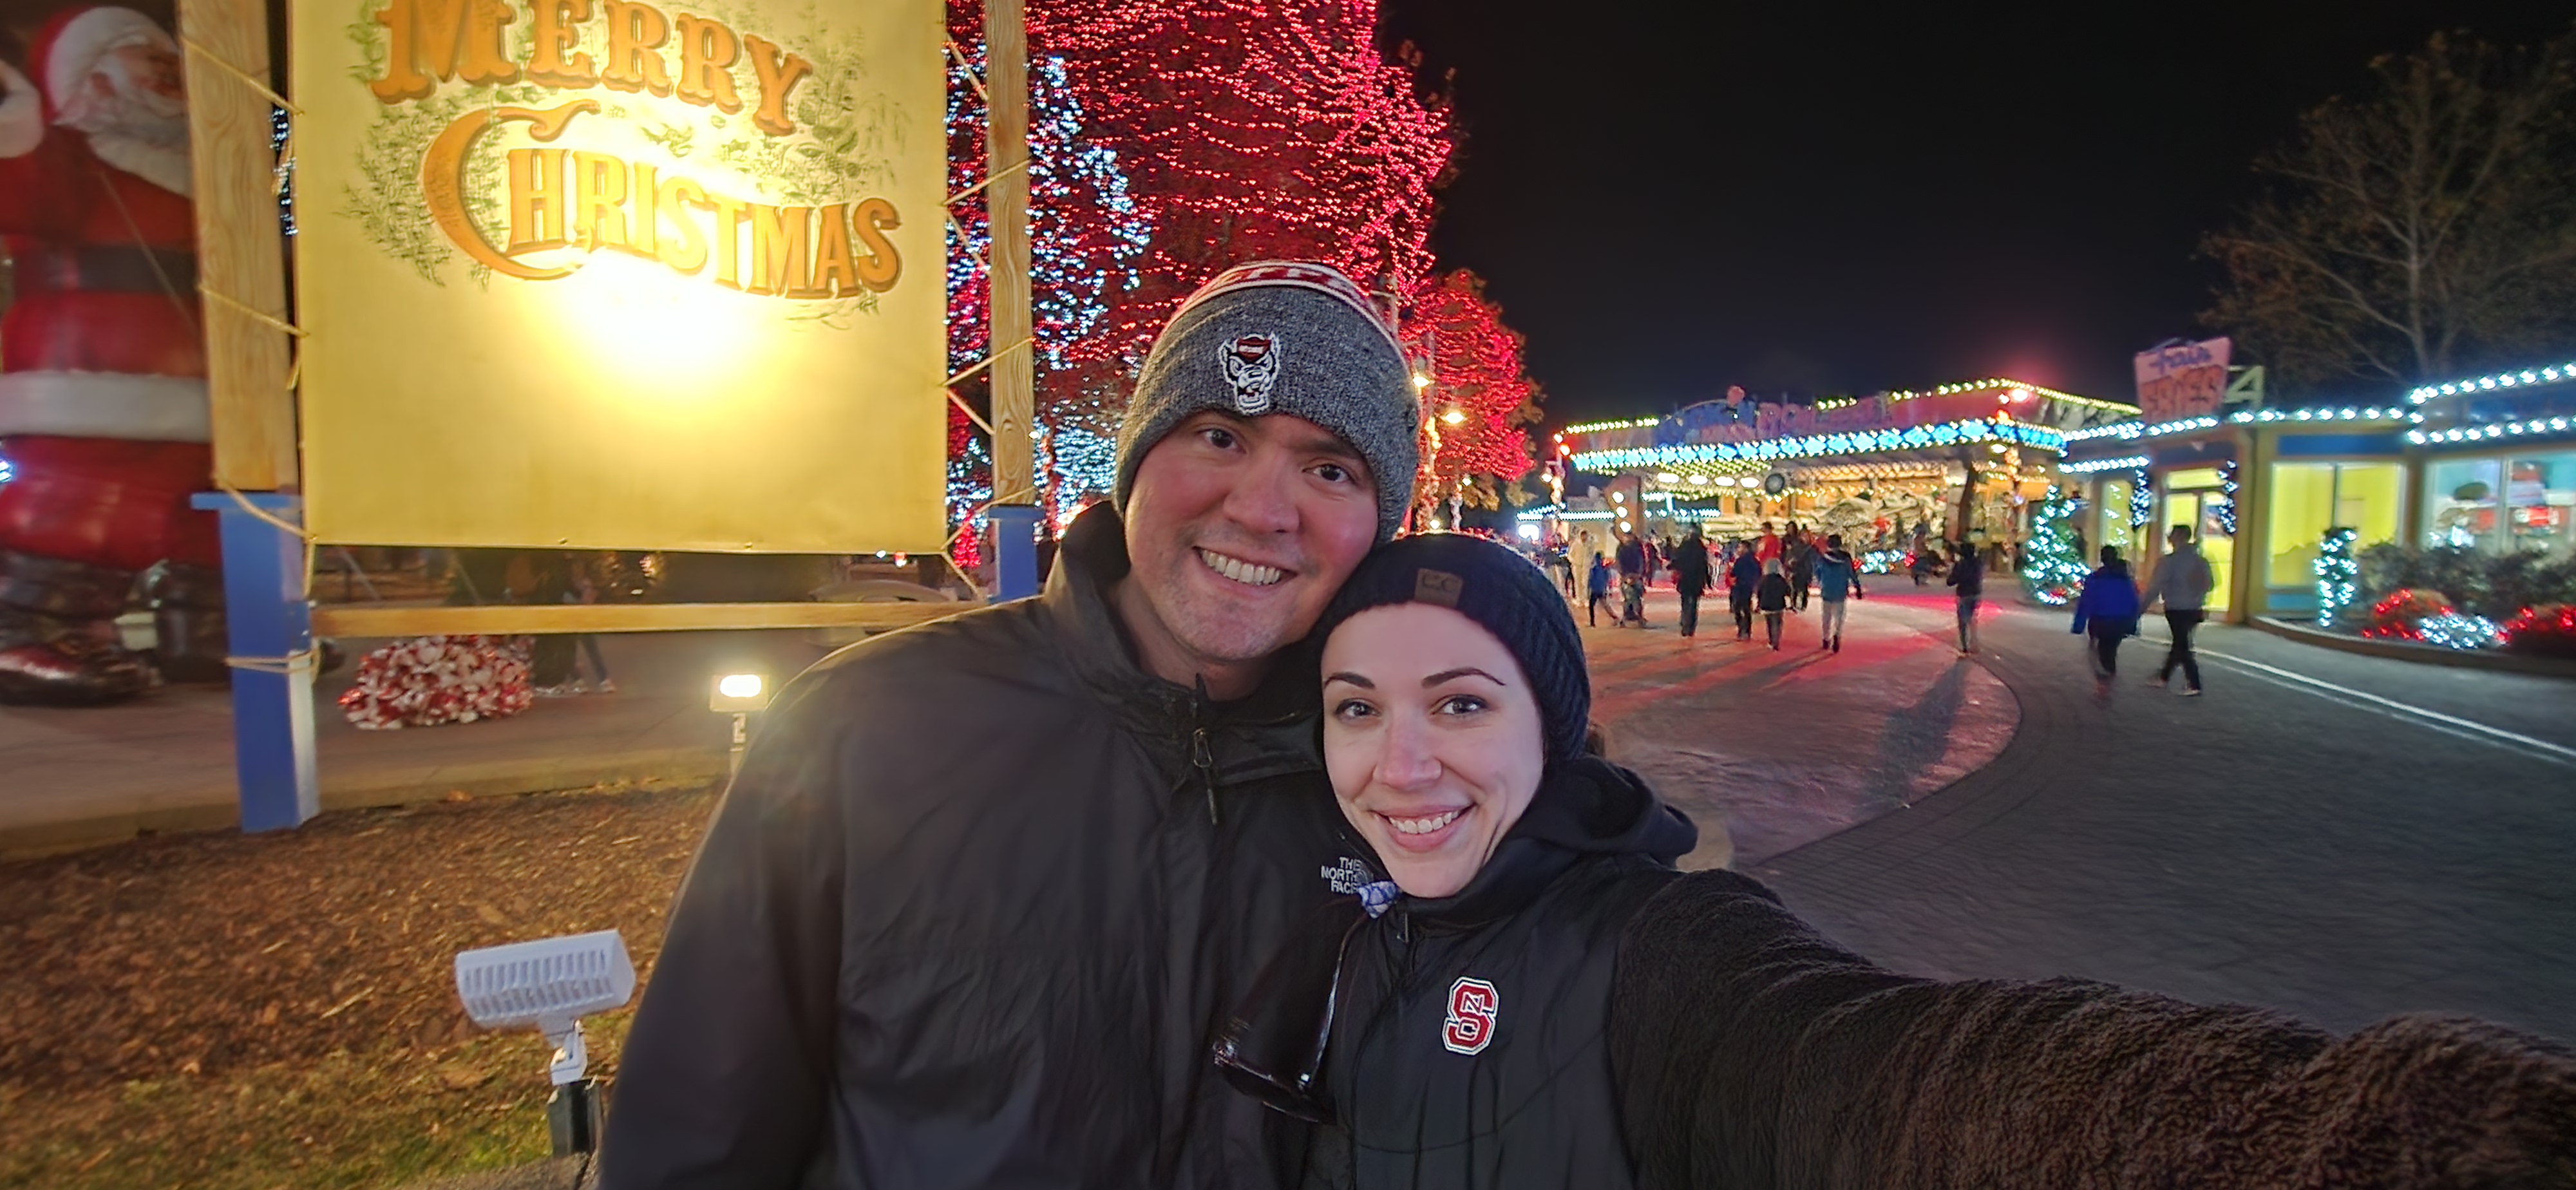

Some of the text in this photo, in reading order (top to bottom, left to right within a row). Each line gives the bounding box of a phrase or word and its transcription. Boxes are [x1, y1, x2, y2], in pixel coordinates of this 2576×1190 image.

[370, 0, 813, 136] MERRY
[423, 99, 903, 299] CHRISTMAS
[1339, 856, 1363, 871] THE
[1320, 865, 1358, 883] NORTH
[1331, 880, 1358, 894] FACE
